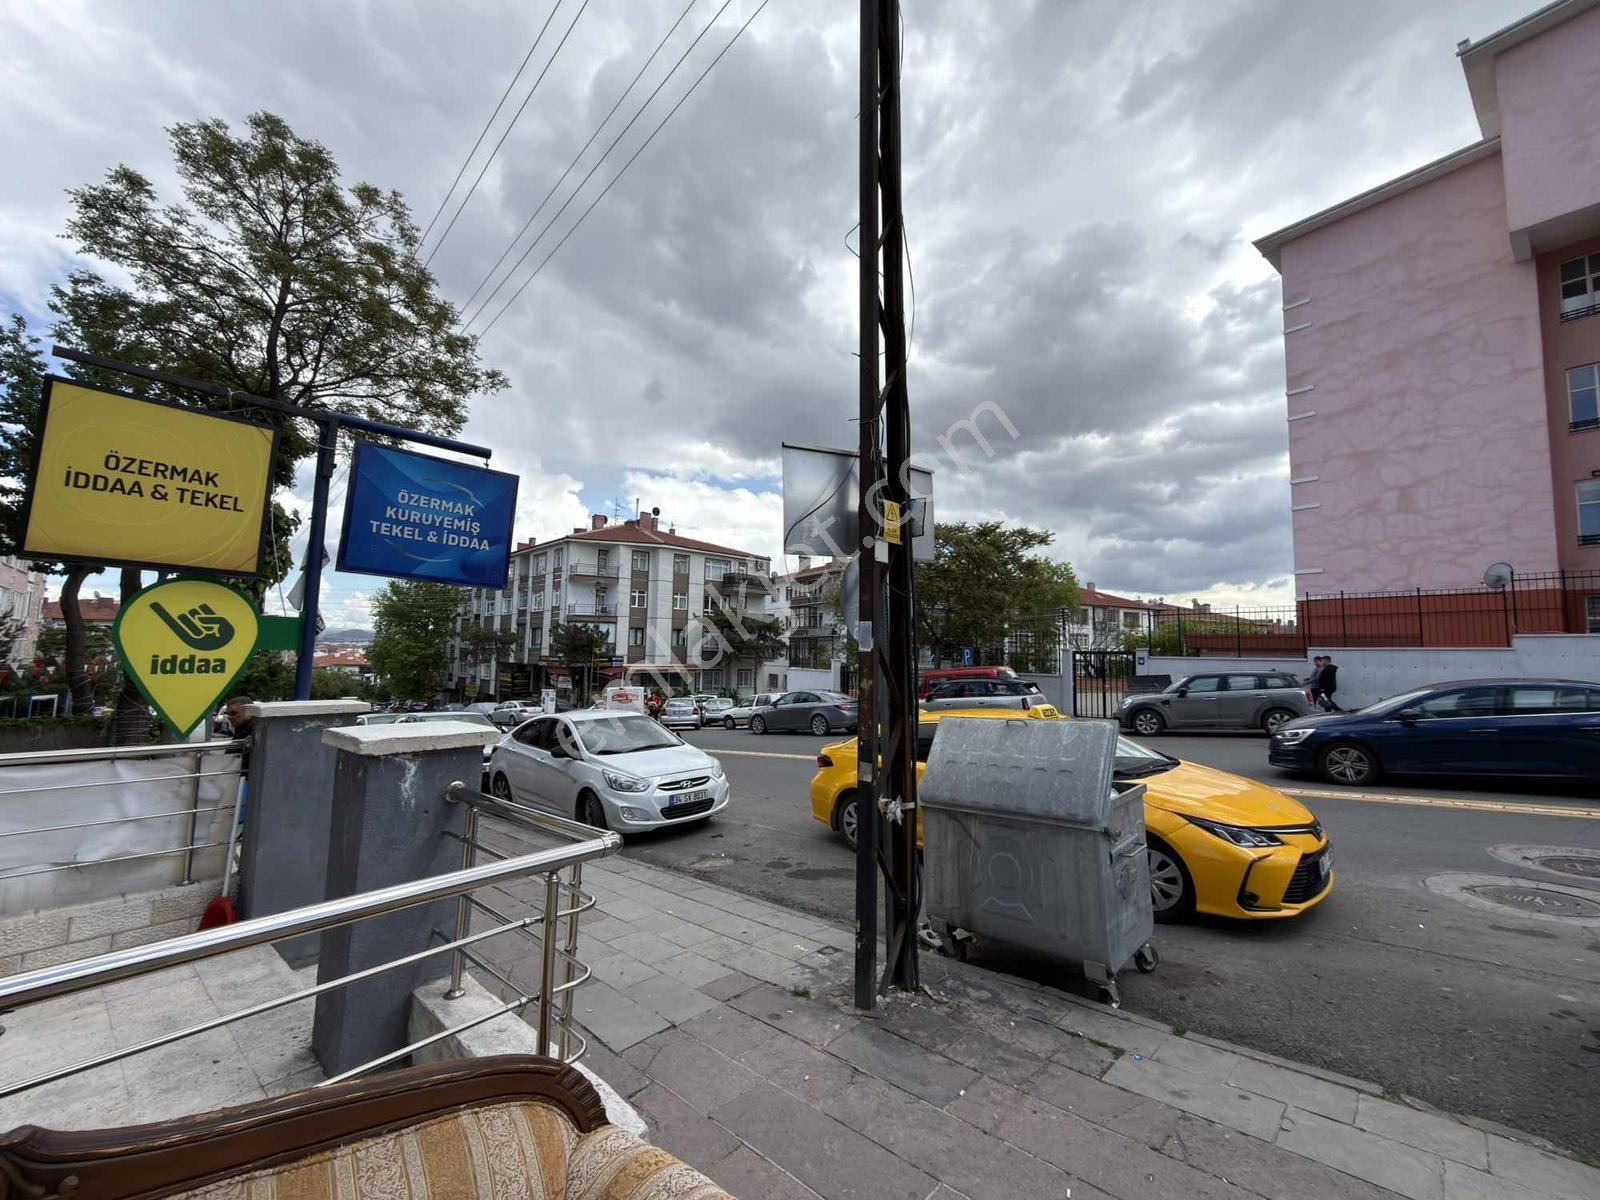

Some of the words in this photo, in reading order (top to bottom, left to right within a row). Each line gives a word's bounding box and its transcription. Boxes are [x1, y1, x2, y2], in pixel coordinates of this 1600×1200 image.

[104, 450, 219, 488] ÖZERMAK
[64, 466, 144, 498] İDDAA
[150, 484, 169, 501] &
[175, 487, 244, 512] TEKEL
[397, 489, 475, 516] ÖZERMAK
[370, 520, 423, 541] TEKEL
[427, 530, 439, 544] &
[443, 530, 490, 551] İDDAA
[385, 506, 481, 536] KURUYEMİŞ
[150, 654, 226, 675] iddaa
